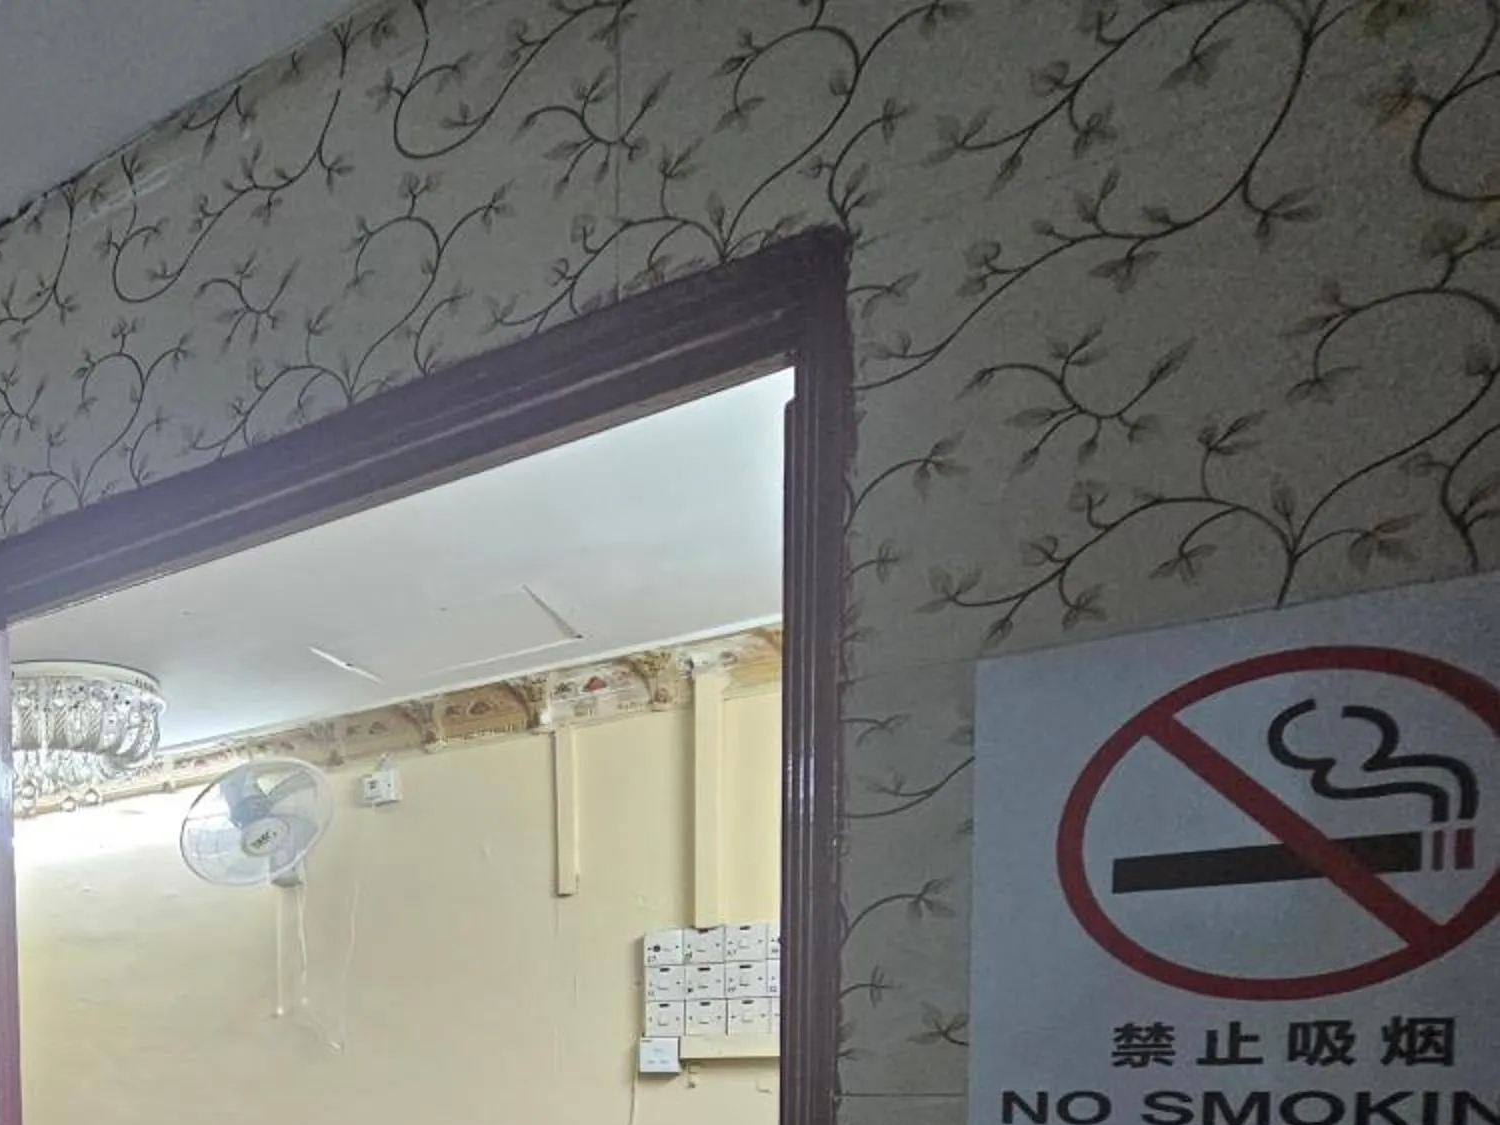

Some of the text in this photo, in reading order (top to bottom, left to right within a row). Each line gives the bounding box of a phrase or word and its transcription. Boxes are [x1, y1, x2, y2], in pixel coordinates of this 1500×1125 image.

[1111, 1016, 1455, 1068] 禁止吸烟
[1001, 1090, 1113, 1125] NO
